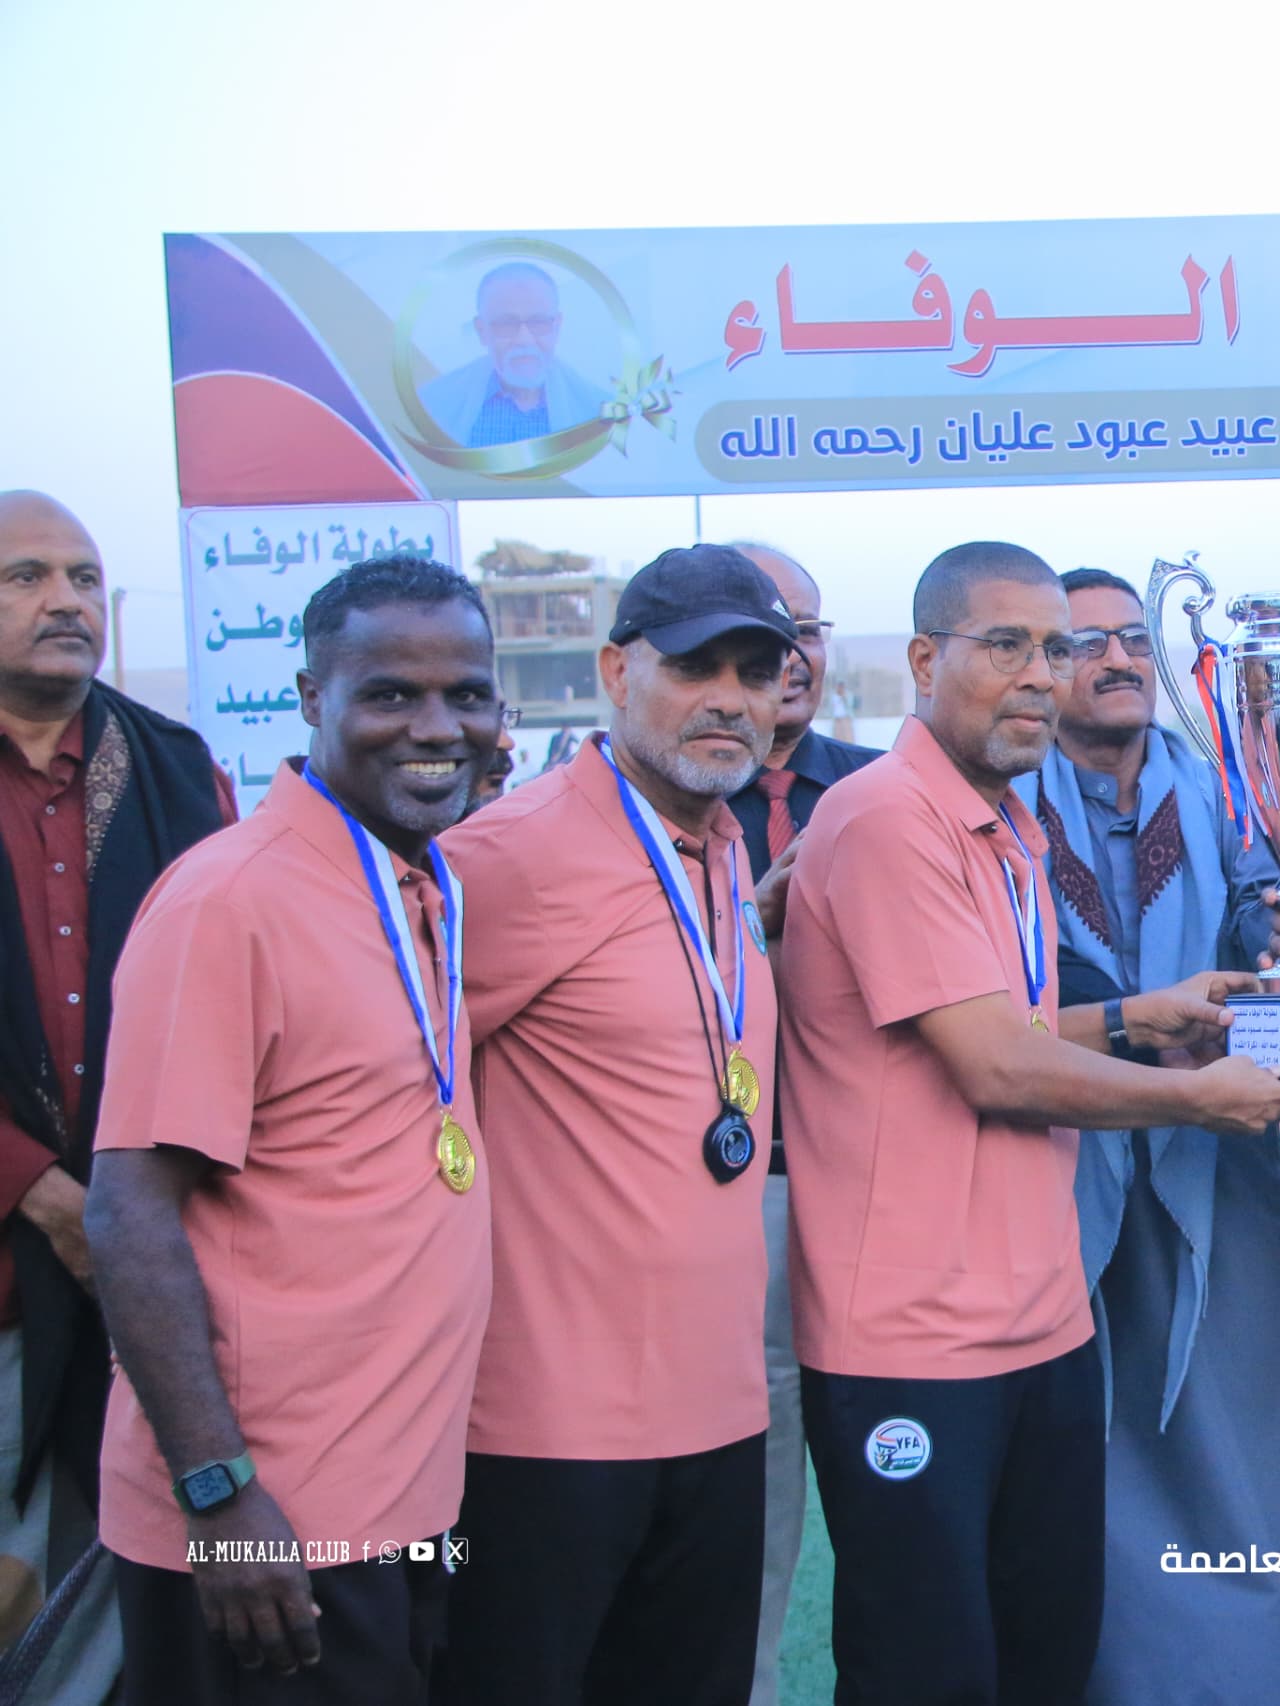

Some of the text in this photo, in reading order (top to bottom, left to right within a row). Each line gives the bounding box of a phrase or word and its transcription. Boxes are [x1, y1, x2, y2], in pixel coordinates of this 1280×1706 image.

[723, 249, 1241, 379] الوفاء
[719, 414, 797, 459] الله
[811, 425, 923, 466] رحمه
[936, 409, 1055, 464] عليان
[1066, 412, 1169, 461] عبود
[1179, 413, 1279, 458] عبيد
[204, 523, 434, 575] بطولة الوفاء
[205, 602, 306, 652] وطن
[216, 681, 301, 726] عبيد
[895, 1436, 921, 1449] YFA
